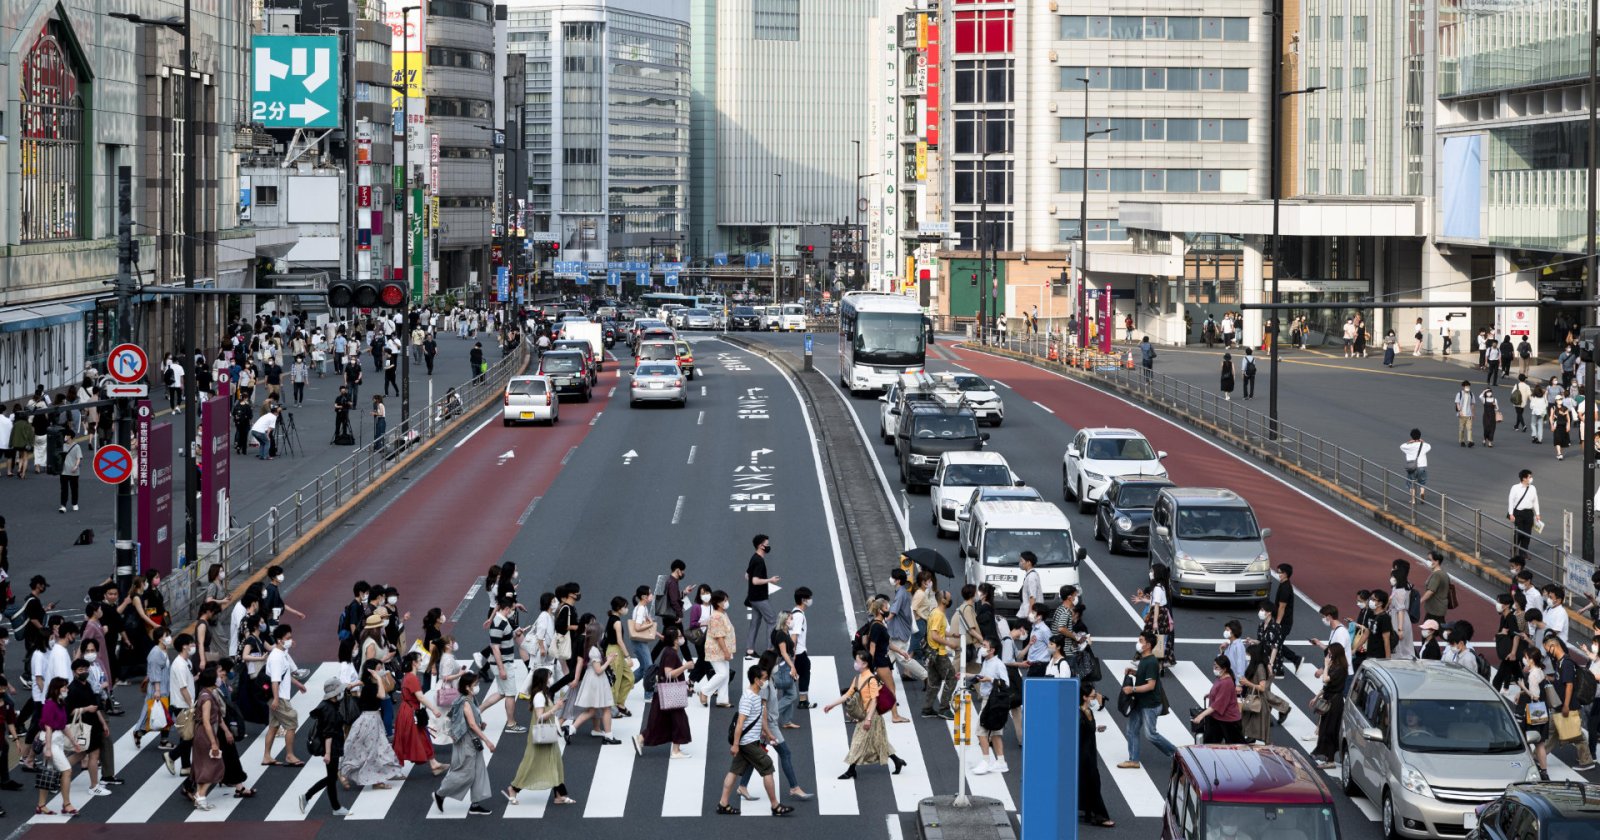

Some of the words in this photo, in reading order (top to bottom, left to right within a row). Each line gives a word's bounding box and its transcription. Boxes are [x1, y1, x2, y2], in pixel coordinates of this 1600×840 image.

[255, 48, 330, 93] トリ
[252, 101, 285, 121] 2分
[414, 213, 422, 234] レイク
